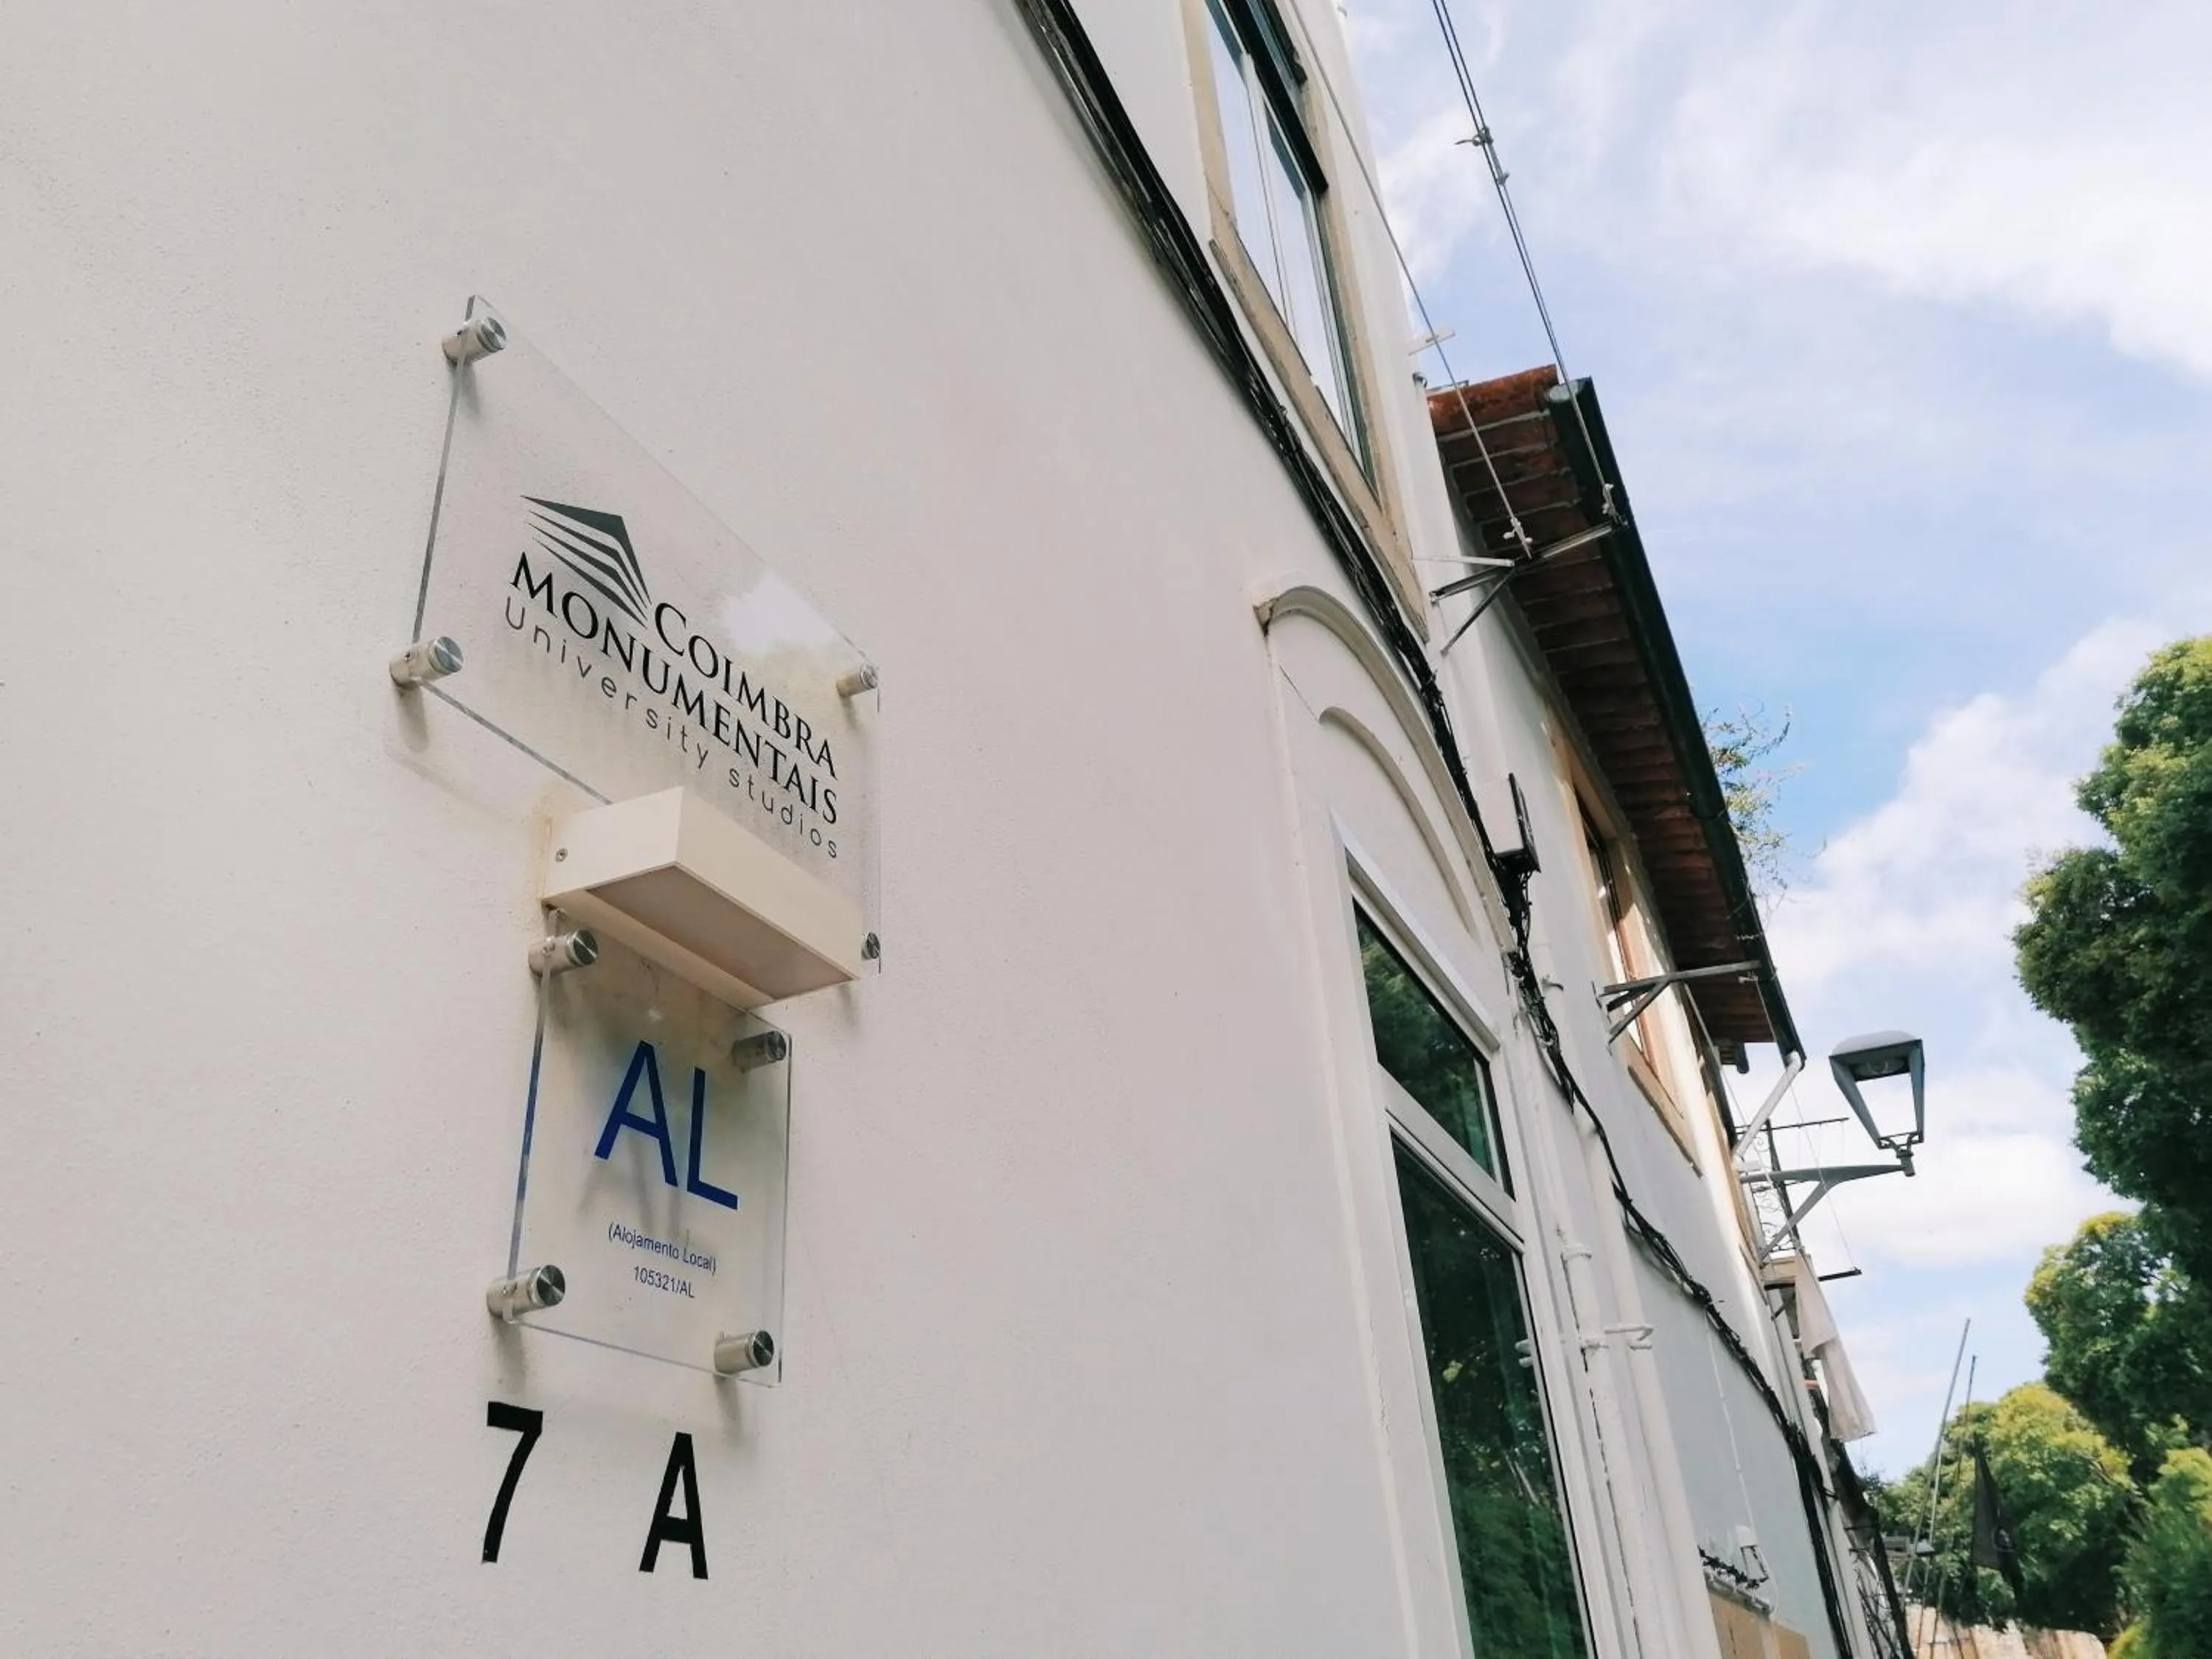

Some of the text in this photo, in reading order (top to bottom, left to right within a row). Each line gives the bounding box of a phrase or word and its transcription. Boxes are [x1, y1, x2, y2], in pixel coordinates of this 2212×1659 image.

[504, 596, 838, 858] University studios
[509, 552, 838, 825] MONUMENTAIS
[654, 602, 838, 780] COIMBRA
[594, 1040, 738, 1211] AL
[608, 1222, 716, 1276] (Alojamento Local)
[633, 1265, 695, 1298] 105321/AL
[481, 1401, 709, 1581] 7 A
